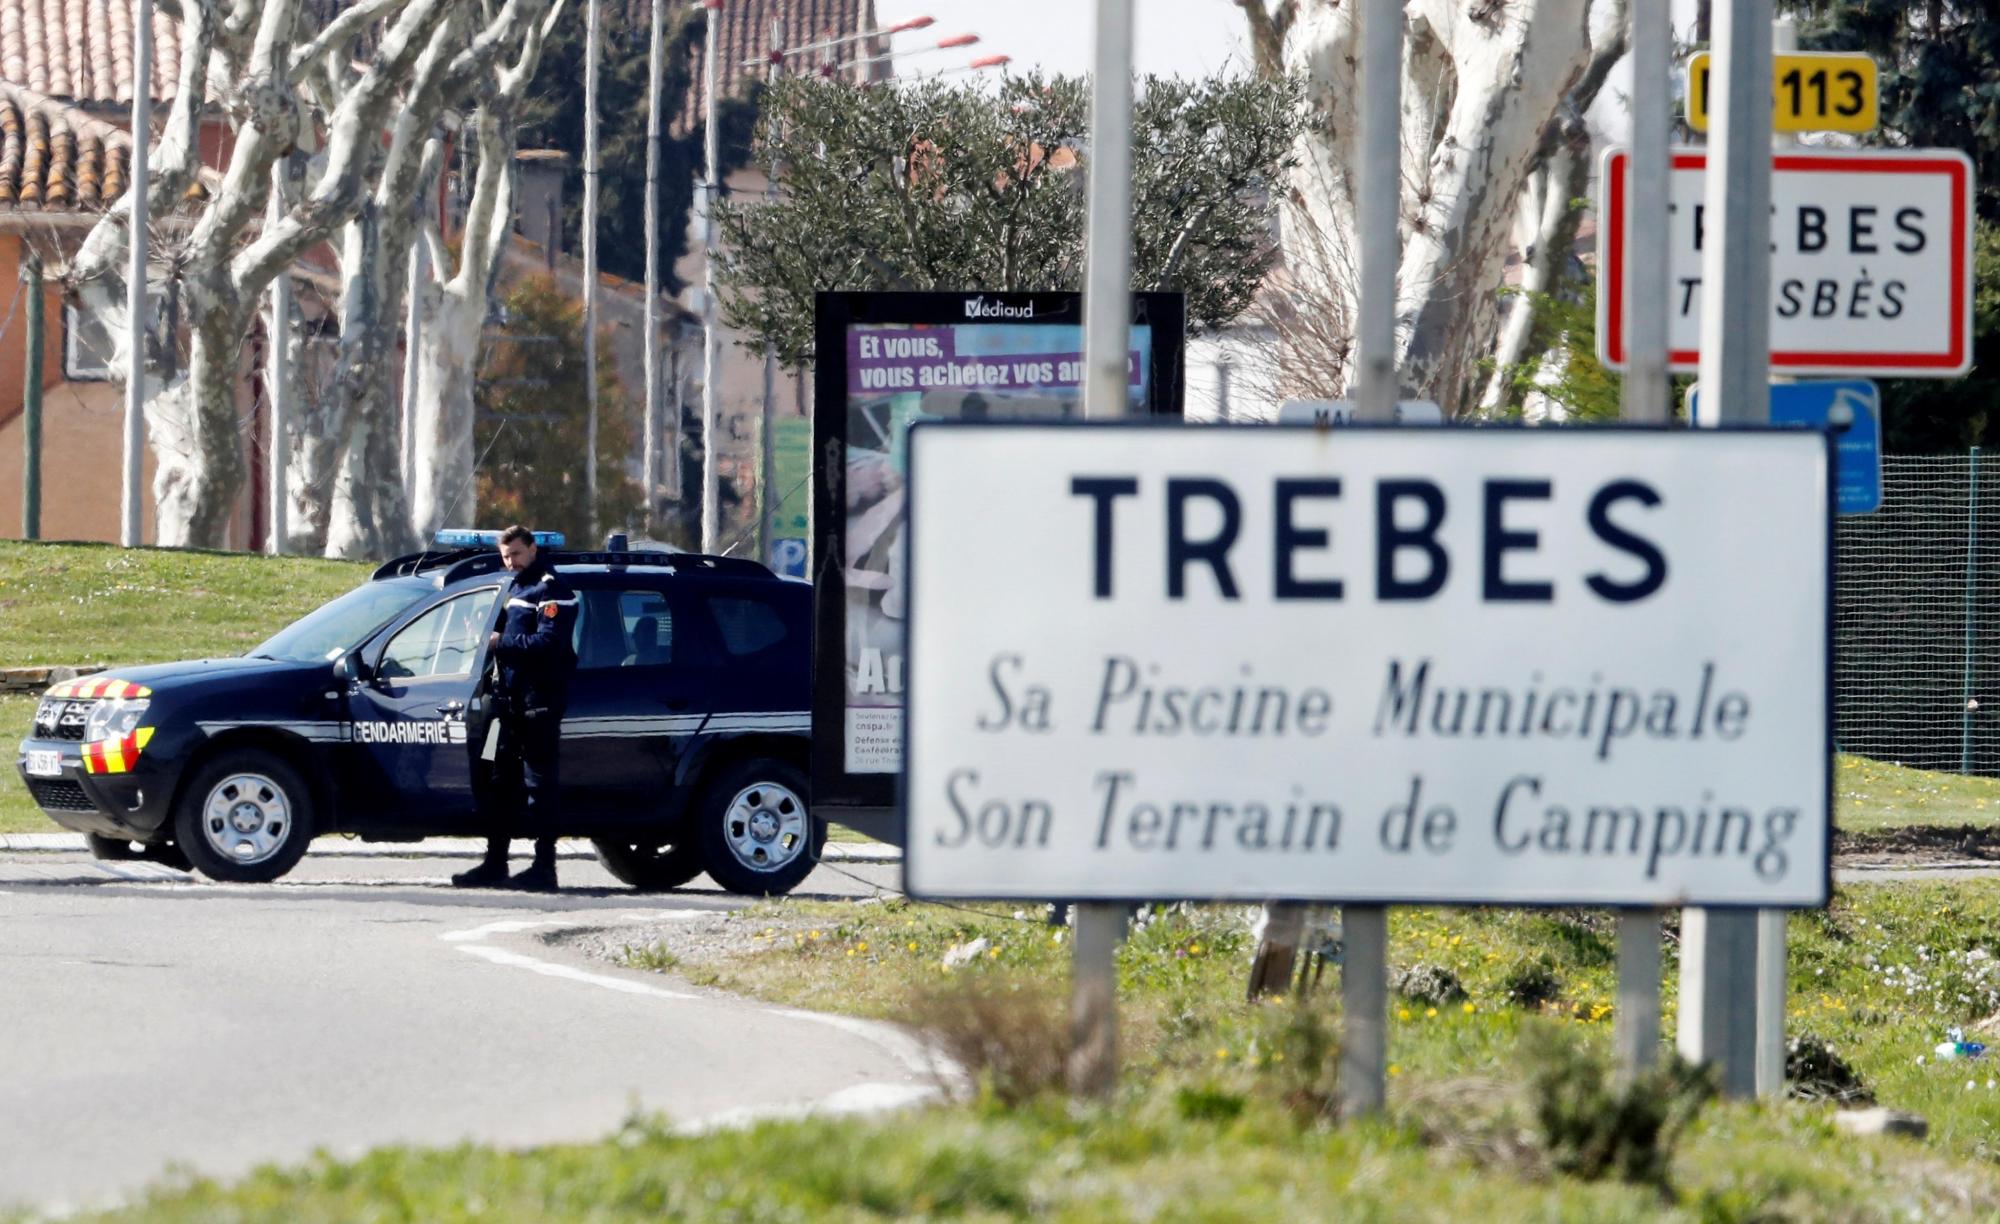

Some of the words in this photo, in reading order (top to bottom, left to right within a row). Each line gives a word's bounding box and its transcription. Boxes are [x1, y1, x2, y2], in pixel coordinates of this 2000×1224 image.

[1671, 204, 1926, 254] BES
[1679, 266, 1906, 319] TSBÈS
[860, 335, 881, 359] Et
[883, 337, 943, 358] vous,
[860, 366, 914, 389] vous
[919, 361, 1010, 386] achetez
[1013, 361, 1054, 384] vos
[1071, 476, 1669, 603] TREBES
[353, 721, 448, 744] GENDARMERIE
[978, 655, 1050, 732] Sa
[1092, 657, 1331, 736] Piscine
[1374, 658, 1751, 763] Municipale
[937, 772, 1051, 849] Son
[1095, 773, 1342, 852] Terrain
[1379, 774, 1458, 855] de
[1491, 775, 1802, 881] Camping
